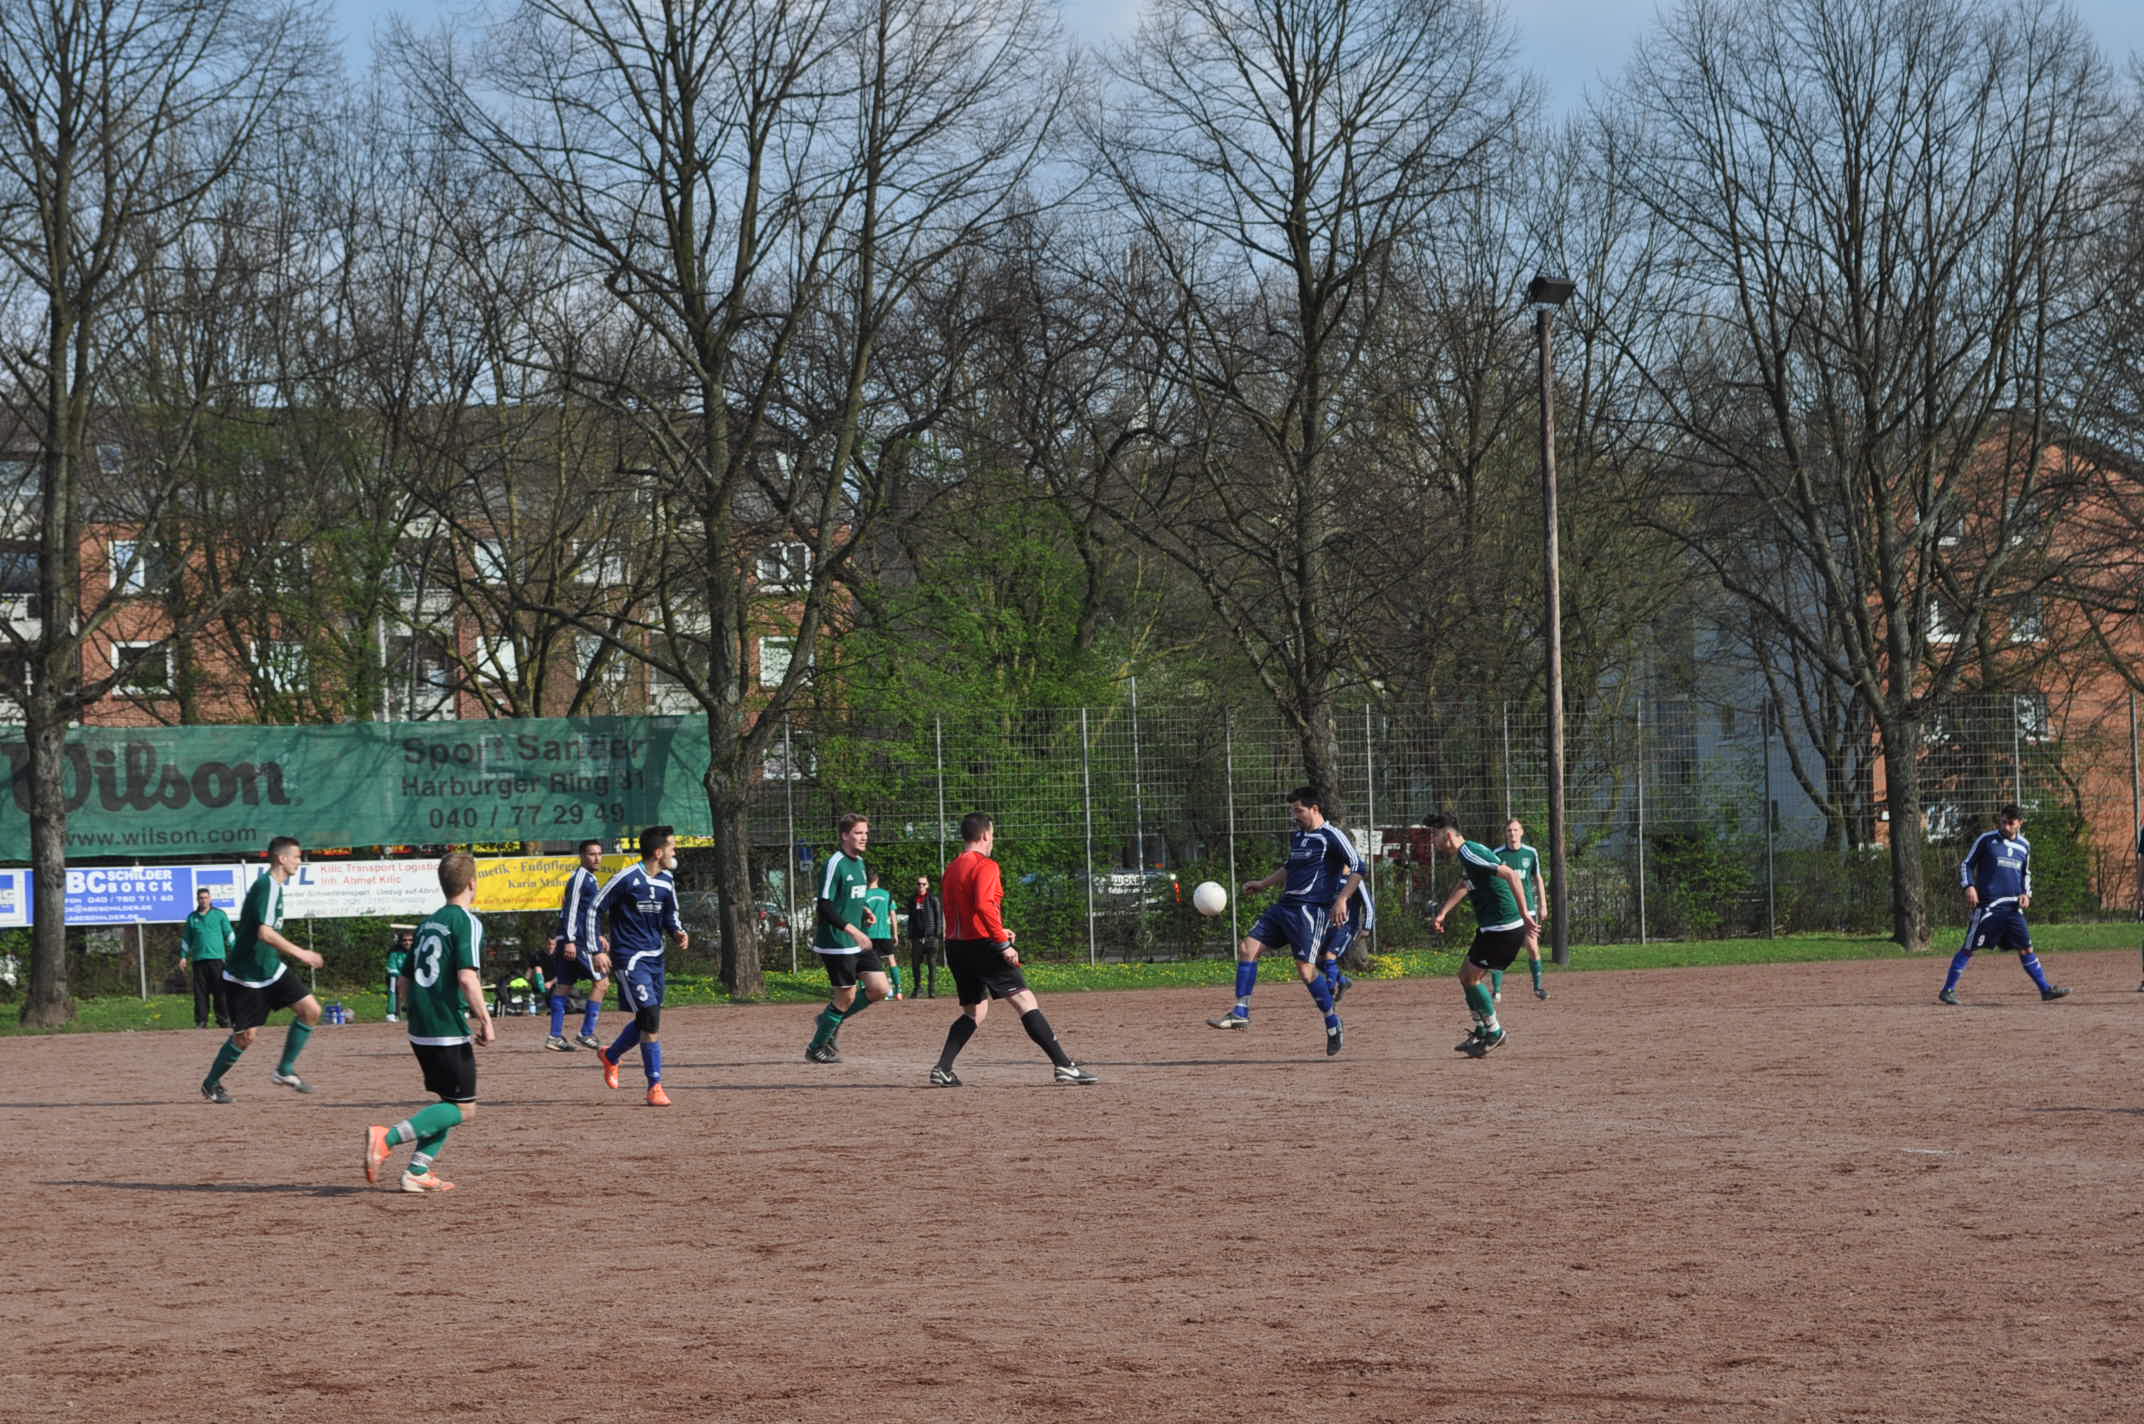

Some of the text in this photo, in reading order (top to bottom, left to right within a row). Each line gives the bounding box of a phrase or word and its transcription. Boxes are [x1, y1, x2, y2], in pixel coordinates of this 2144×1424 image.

[403, 734, 646, 769] Sport Sander
[0, 739, 291, 812] Wilson
[402, 775, 540, 800] Harburger
[550, 773, 608, 796] Ring
[430, 803, 624, 829] 040 / 77 29 49
[107, 869, 173, 881] SCHILDER
[347, 863, 396, 874] Transport
[66, 871, 107, 894] BC
[108, 882, 174, 893] BORCK
[636, 983, 649, 1001] 3
